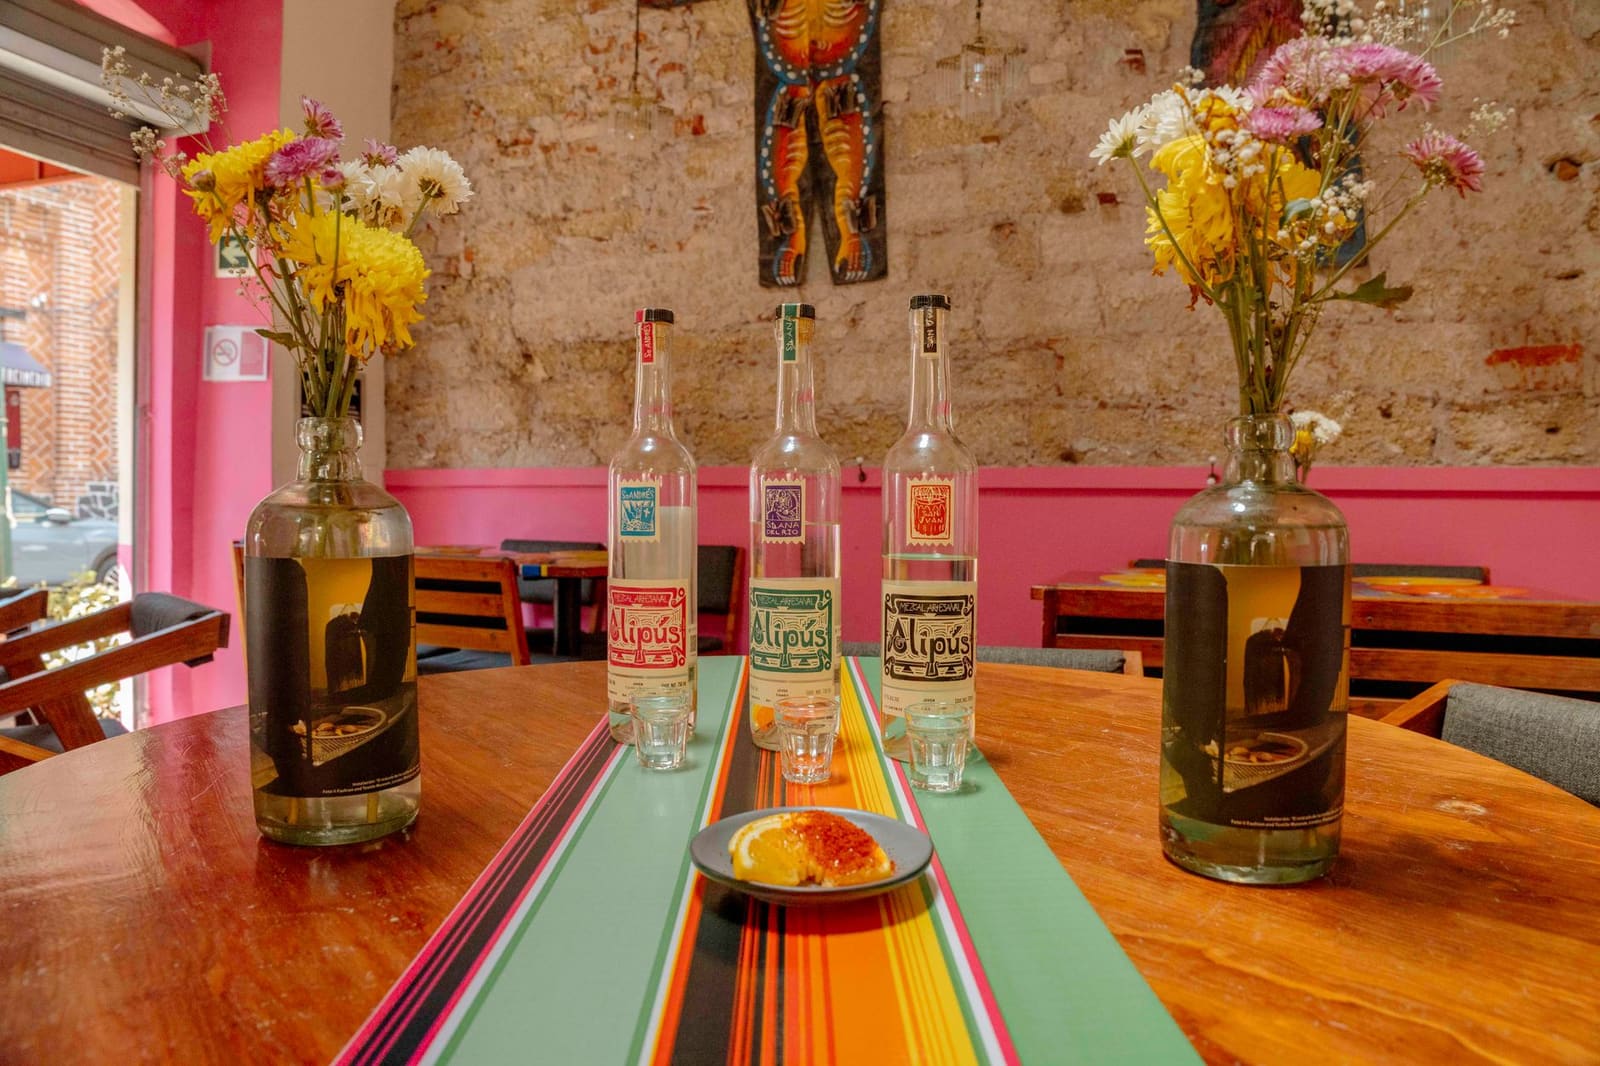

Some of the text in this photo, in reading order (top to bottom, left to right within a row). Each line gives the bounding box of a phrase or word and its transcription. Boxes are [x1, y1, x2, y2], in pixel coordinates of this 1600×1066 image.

[609, 607, 680, 659] Alipús
[752, 609, 827, 663] Alipús
[887, 617, 970, 671] Alipús
